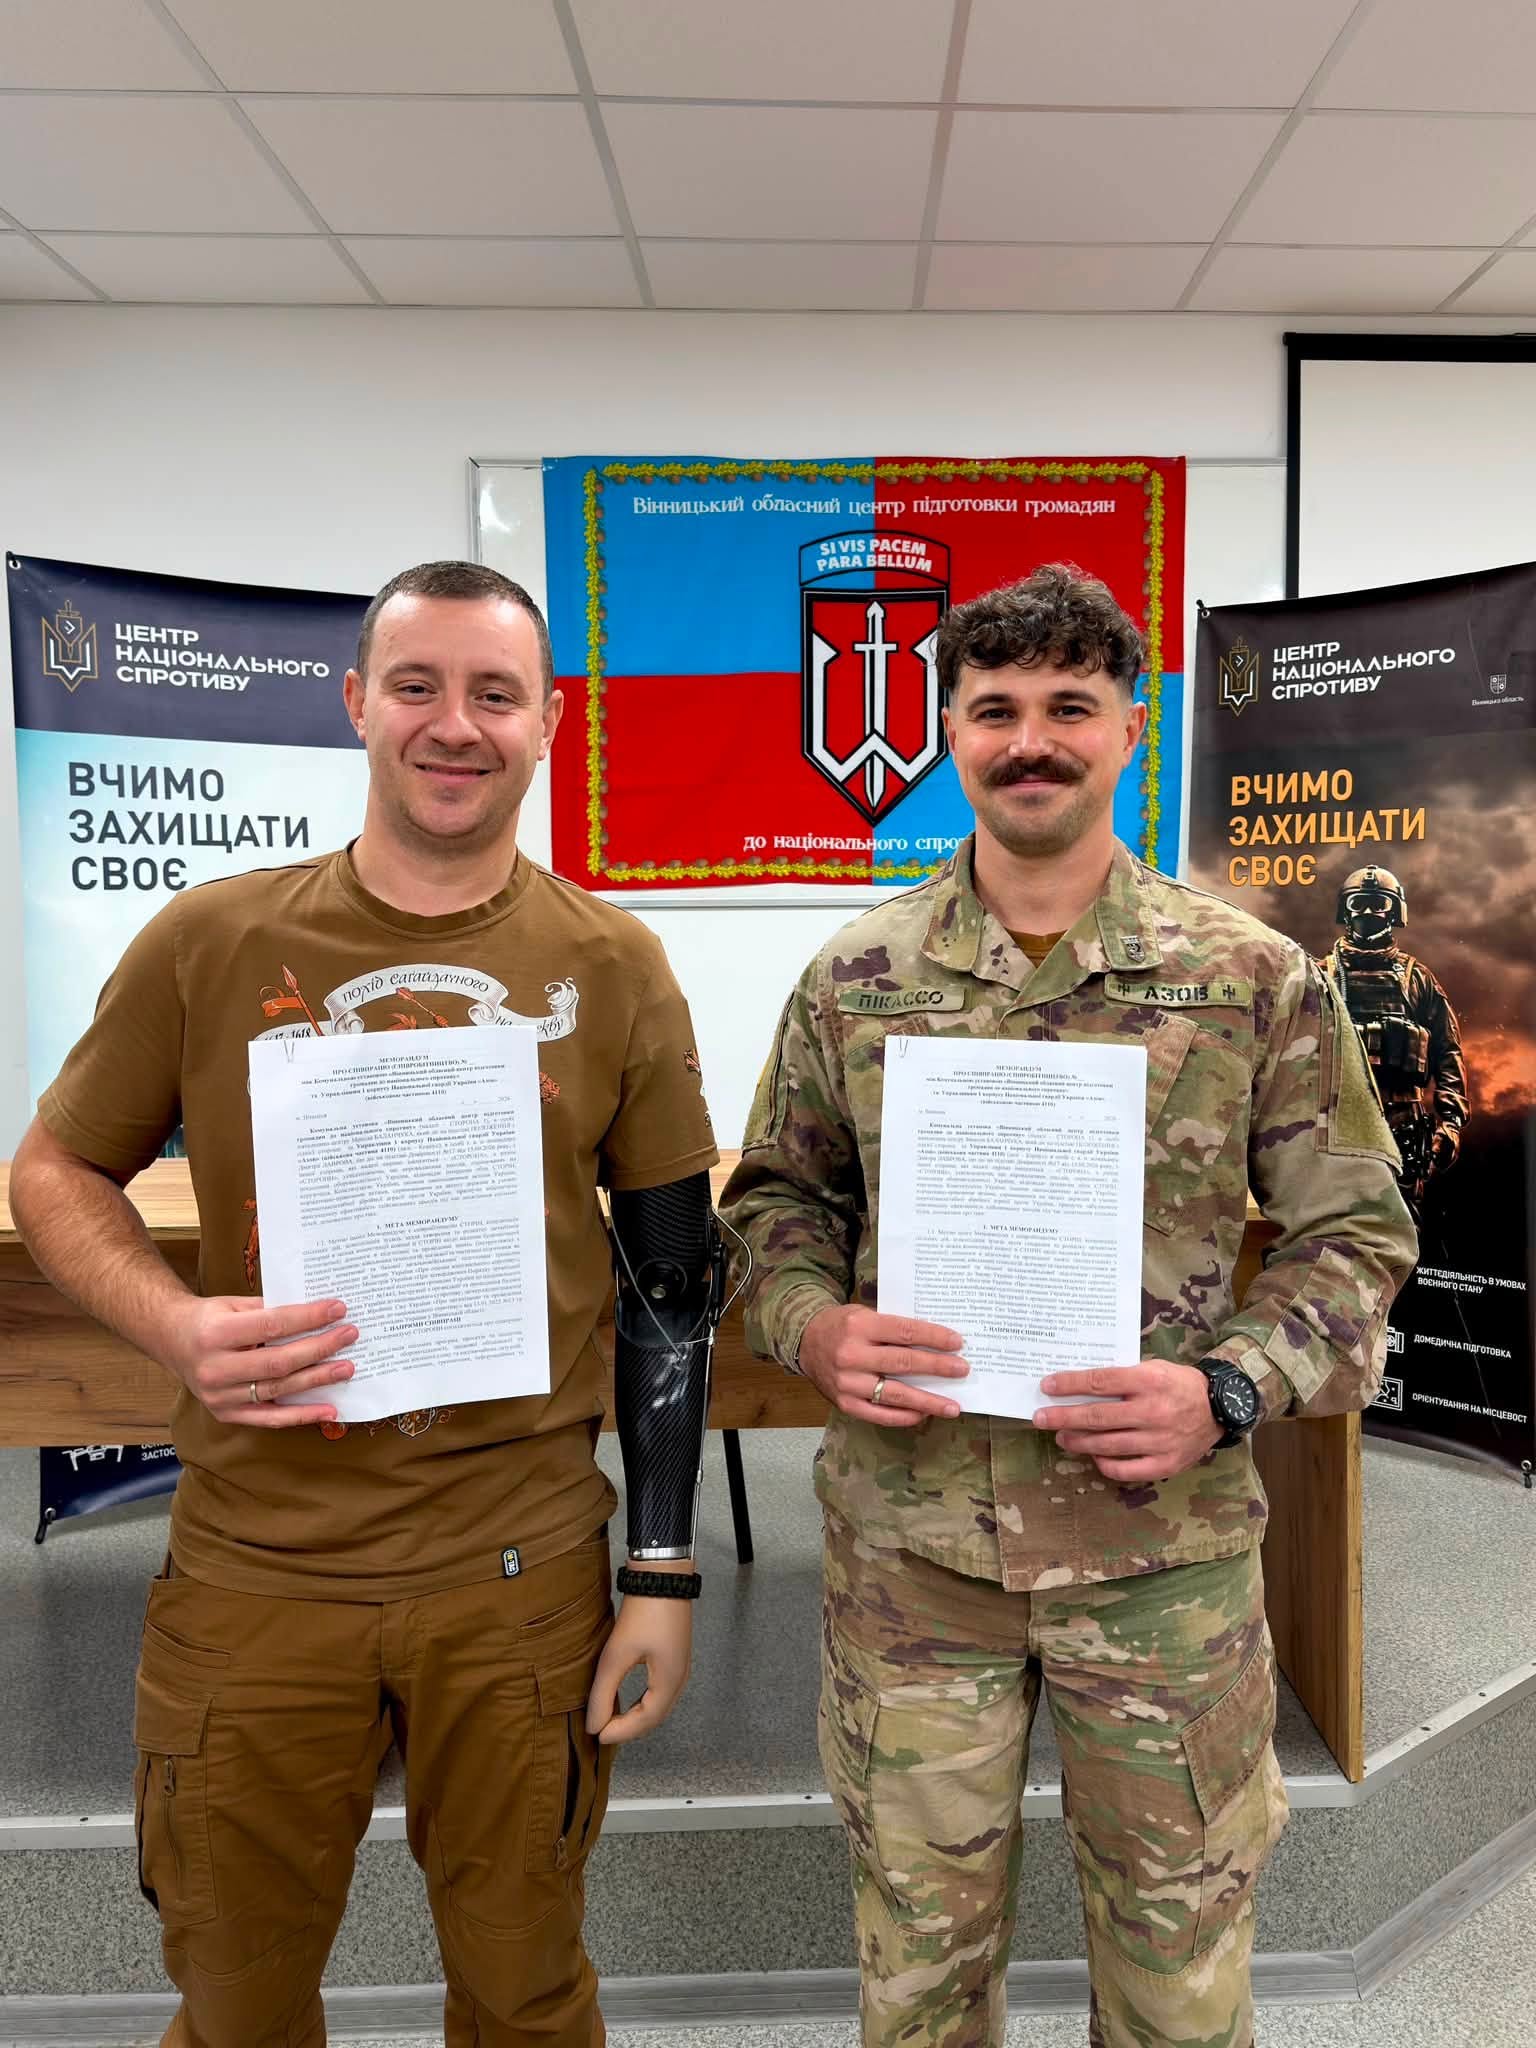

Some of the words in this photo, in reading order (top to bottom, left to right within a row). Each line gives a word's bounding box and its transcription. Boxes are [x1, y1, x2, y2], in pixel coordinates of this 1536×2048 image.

[633, 496, 744, 515] Вінницький
[752, 494, 841, 514] обласний
[848, 500, 906, 517] центр
[912, 496, 1018, 515] підготовки
[1025, 499, 1116, 517] громадян
[820, 542, 836, 556] SI
[838, 540, 865, 553] VIS
[869, 539, 927, 556] PACEM
[816, 555, 863, 572] PARA
[866, 554, 933, 572] BELLUM
[115, 623, 199, 646] ЦЕНТР
[115, 644, 330, 678] НАЦІОНАЛЬНОГО
[1273, 641, 1340, 664] ЦЕНТР
[1272, 648, 1456, 682] НАЦІОНАЛЬНОГО
[116, 665, 250, 691] СПРОТИВУ
[1272, 676, 1381, 700] СПРОТИВУ
[69, 762, 224, 802] ВЧИМО
[1231, 769, 1353, 807] ВЧИМО
[69, 809, 309, 854] ЗАХИЩАТИ
[1228, 807, 1425, 849] ЗАХИЩАТИ
[743, 836, 767, 851] до
[773, 832, 908, 851] національного
[915, 837, 965, 854] спро
[72, 856, 188, 891] СВОЄ
[1228, 854, 1317, 886] СВОЄ
[859, 990, 944, 1009] ПІКАССО
[1144, 985, 1209, 1001] АЗОВ
[379, 1055, 429, 1063] МЕМОРАНДУМ
[405, 1215, 459, 1227] МЕМОРАНДУМУ
[1416, 1266, 1488, 1284] ЖИТТЄДІЯЛЬНІСТЬ
[1488, 1277, 1495, 1285] В
[1495, 1278, 1526, 1291] УМОВАХ
[1417, 1277, 1458, 1290] ВОЄННОГО
[1458, 1283, 1484, 1294] СТАНУ
[1413, 1334, 1462, 1350] ДОМЕДИЧНА
[1463, 1342, 1512, 1359] ПІДГОТОВКА
[1412, 1393, 1469, 1412] ОРІЄНТУВАННЯ
[1470, 1404, 1482, 1414] НА
[141, 1447, 177, 1461] ЗАСТОС
